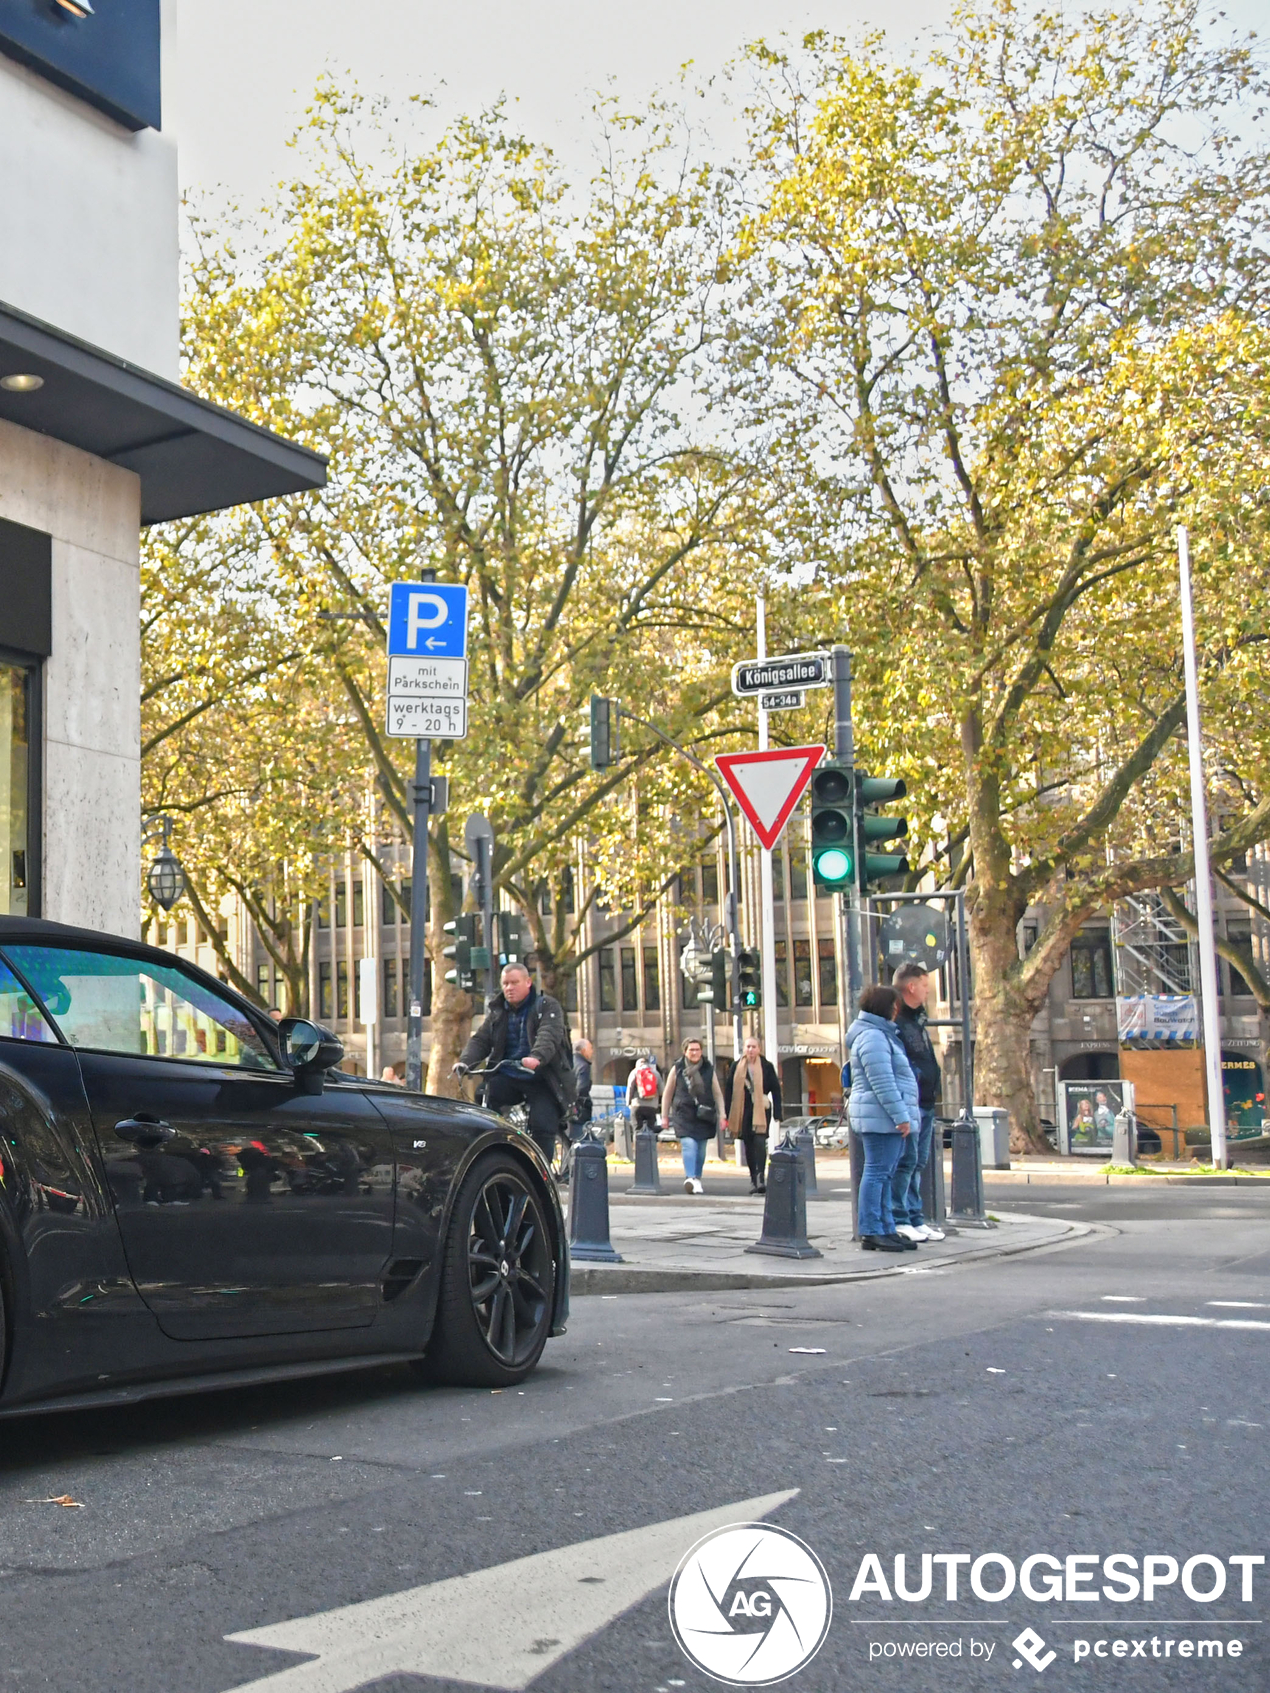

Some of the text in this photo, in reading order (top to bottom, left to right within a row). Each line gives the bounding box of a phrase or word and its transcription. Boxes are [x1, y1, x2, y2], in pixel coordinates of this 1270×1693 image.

[406, 592, 449, 649] P
[418, 666, 436, 676] mit
[745, 664, 815, 685] Königsallee
[394, 677, 460, 690] Parkschein
[763, 694, 797, 708] 54-34a
[393, 702, 460, 718] werktags
[396, 717, 404, 730] 9
[425, 718, 441, 731] 20
[448, 717, 456, 731] h
